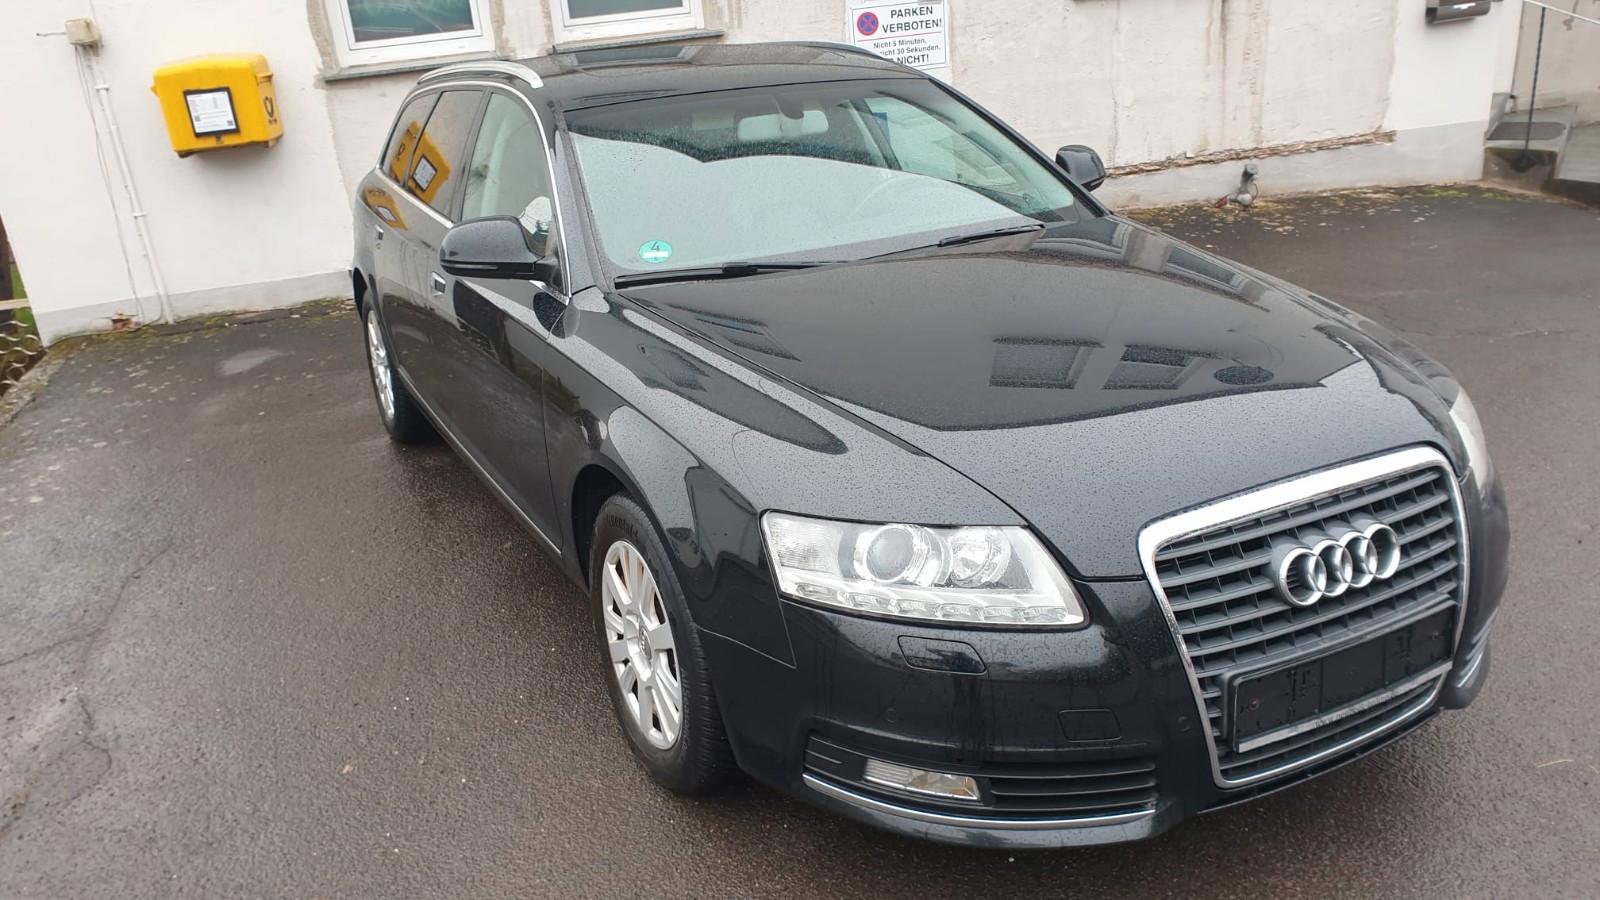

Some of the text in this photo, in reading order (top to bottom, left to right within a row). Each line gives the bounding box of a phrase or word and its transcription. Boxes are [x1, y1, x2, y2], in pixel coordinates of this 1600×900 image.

[890, 6, 933, 19] PARKEN
[882, 18, 942, 33] VERBOTEN!
[873, 41, 891, 49] Nicht
[897, 53, 929, 65] NICHT!
[650, 241, 661, 252] 4
